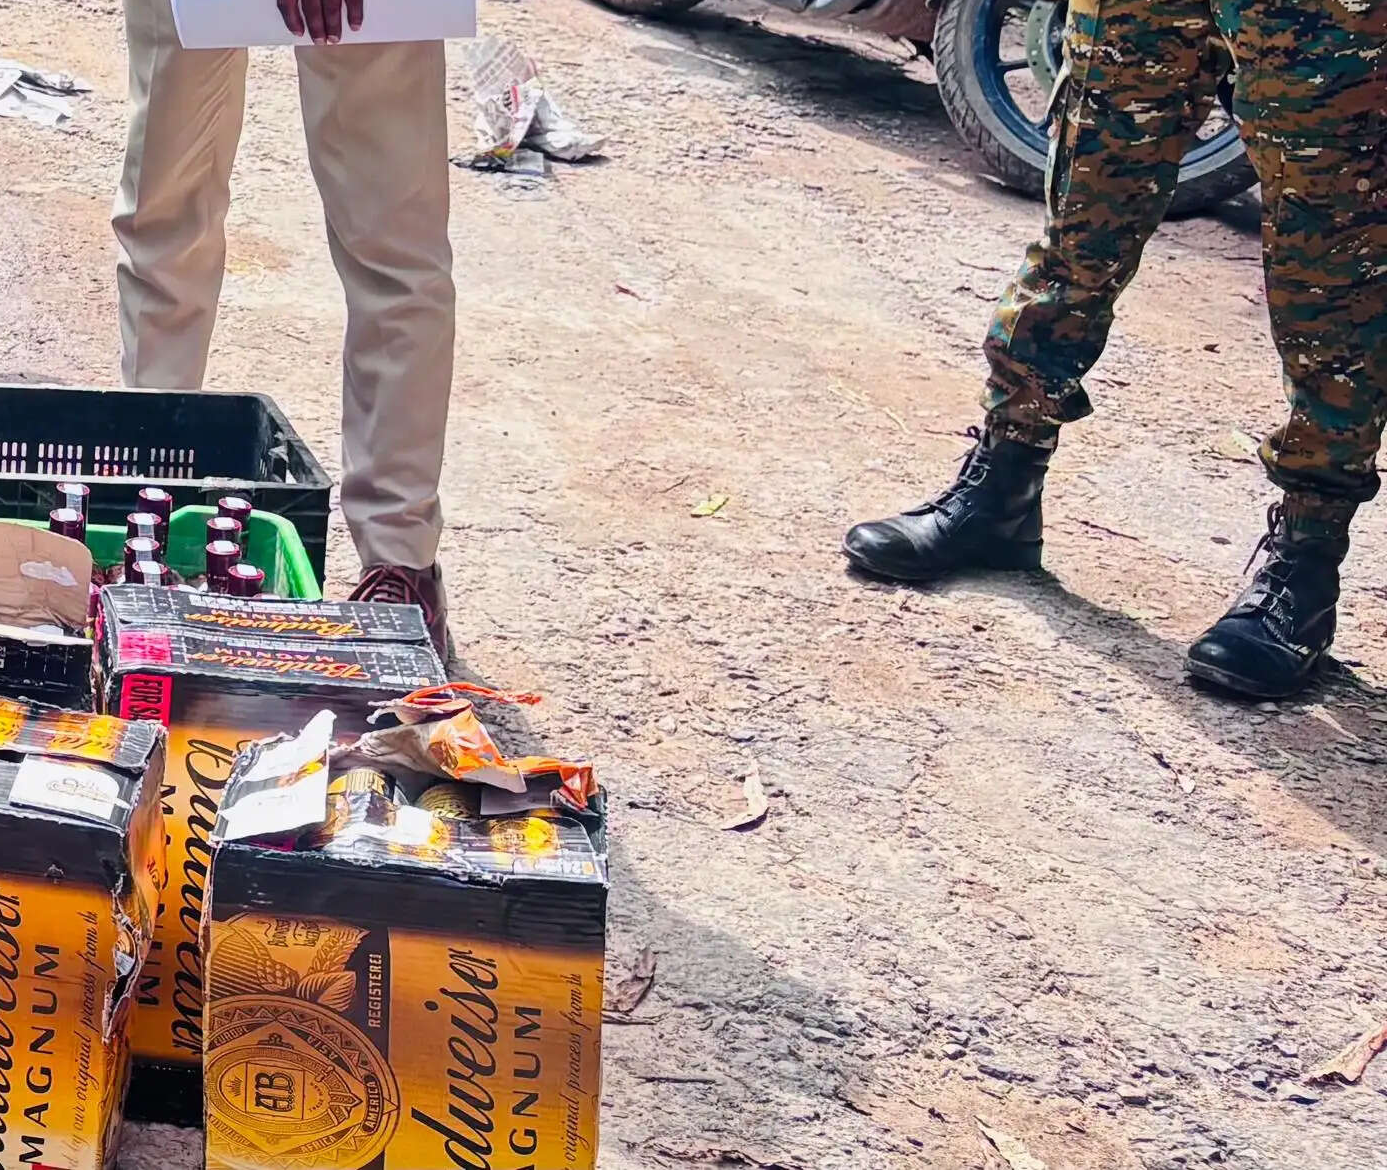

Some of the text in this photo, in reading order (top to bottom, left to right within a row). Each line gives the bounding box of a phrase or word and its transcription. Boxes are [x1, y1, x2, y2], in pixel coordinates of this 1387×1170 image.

[185, 612, 364, 638] Budweiser
[211, 609, 328, 623] MAGNUM
[190, 651, 371, 680] Budweiser
[215, 647, 334, 662] MAGNUM
[129, 678, 164, 702] FOR
[76, 932, 107, 974] from
[80, 972, 100, 1033] process
[559, 988, 592, 1031] from
[18, 944, 60, 1164] MAGNUM
[74, 1030, 100, 1100] original
[307, 1035, 339, 1060] ASIA
[566, 1031, 588, 1095] process
[366, 1080, 381, 1129] AMERICA
[508, 1006, 543, 1170] GNUM
[300, 1135, 338, 1154] AFRICA
